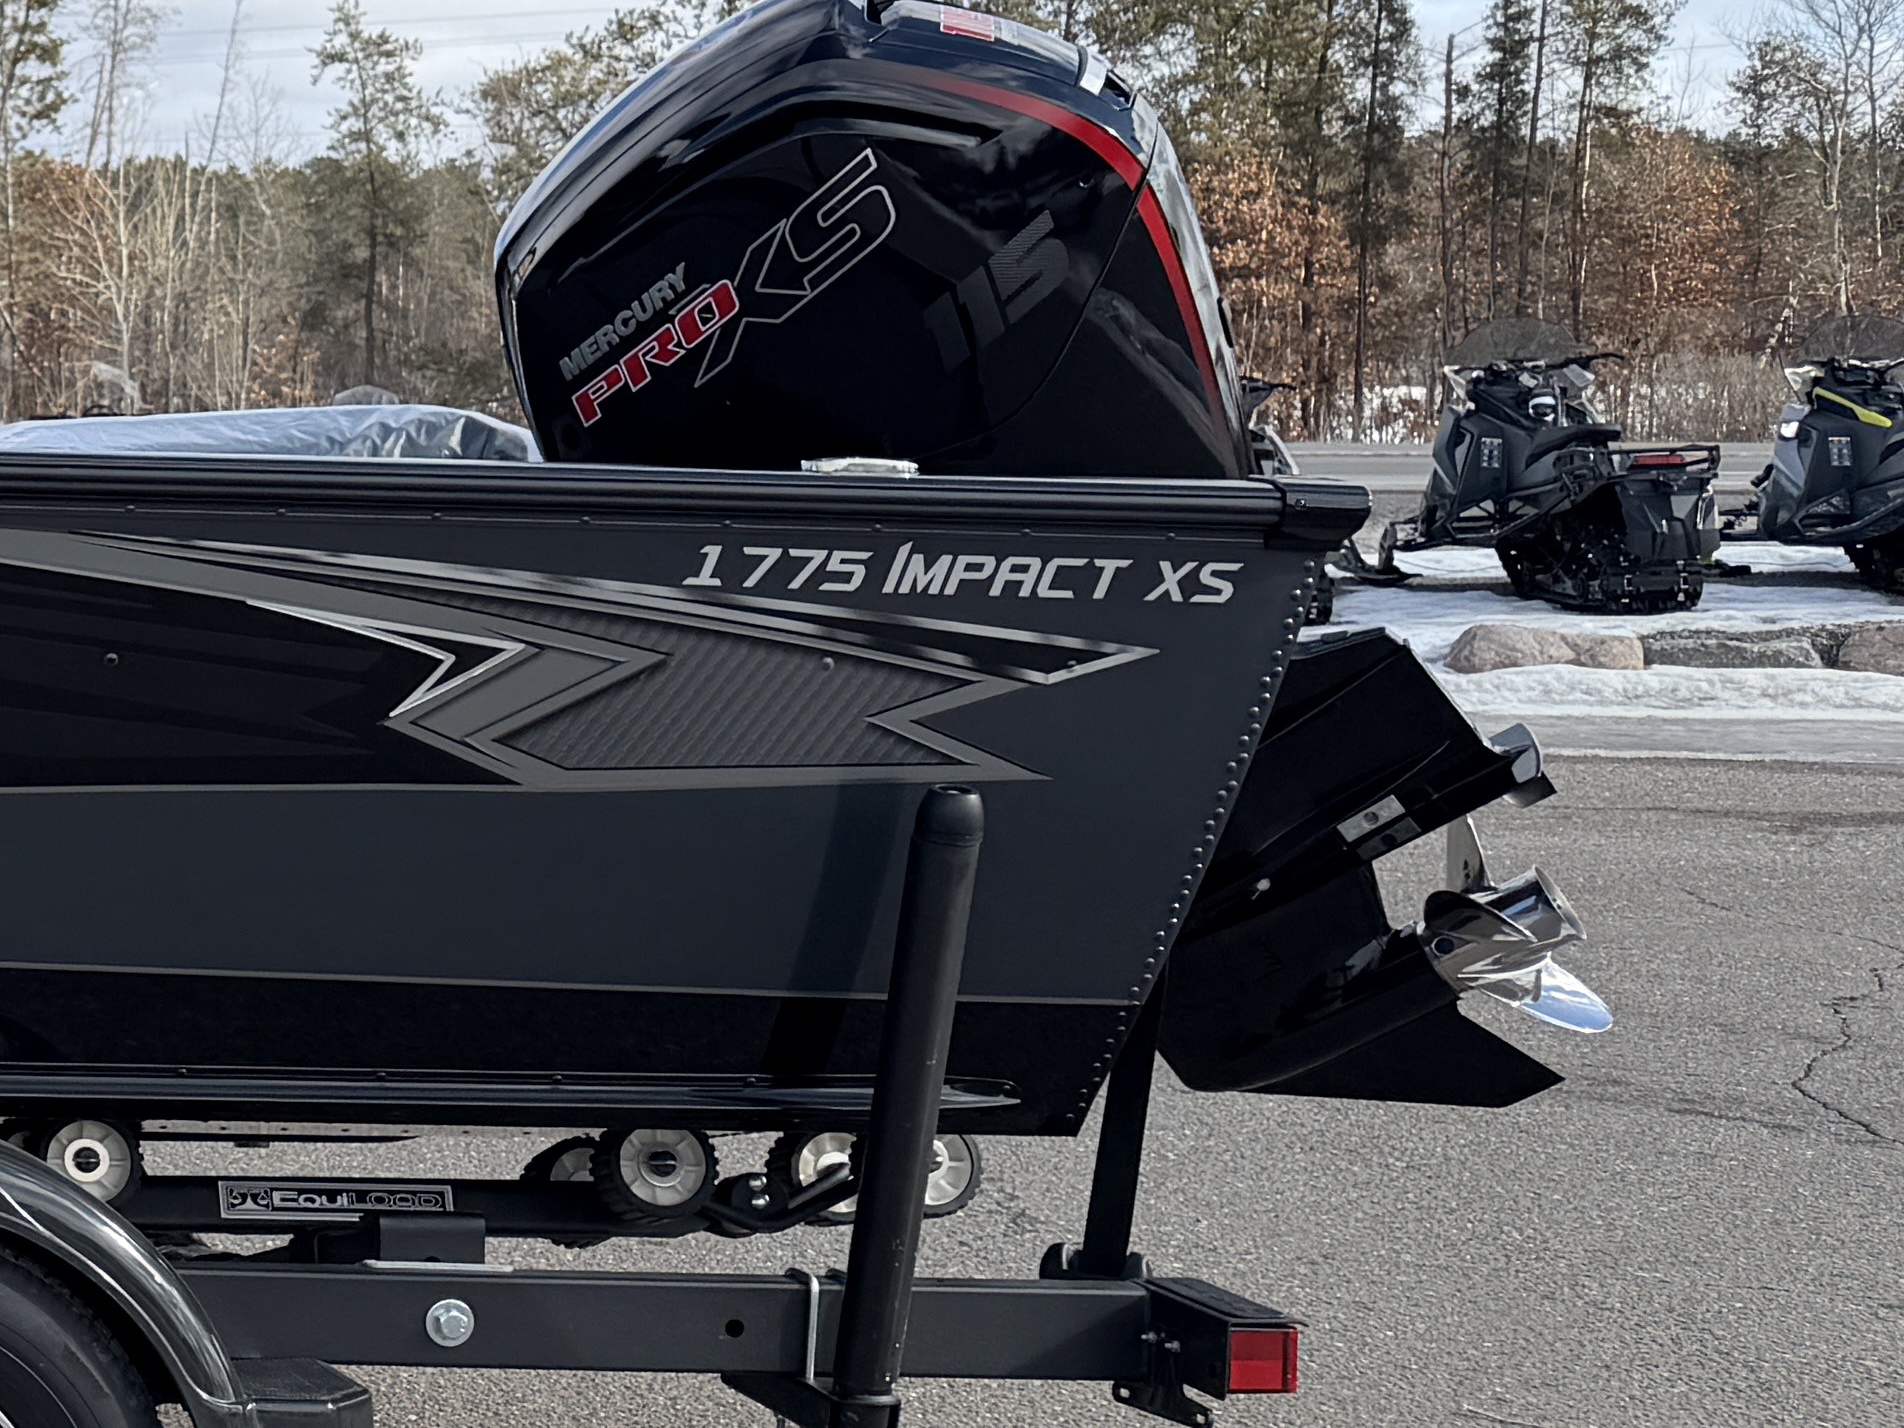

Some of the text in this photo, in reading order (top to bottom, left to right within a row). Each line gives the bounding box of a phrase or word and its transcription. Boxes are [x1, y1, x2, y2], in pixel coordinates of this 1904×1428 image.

[558, 261, 685, 381] MERCURY
[572, 148, 895, 427] PRO XS
[681, 541, 1245, 604] 1775 IMPACT XS
